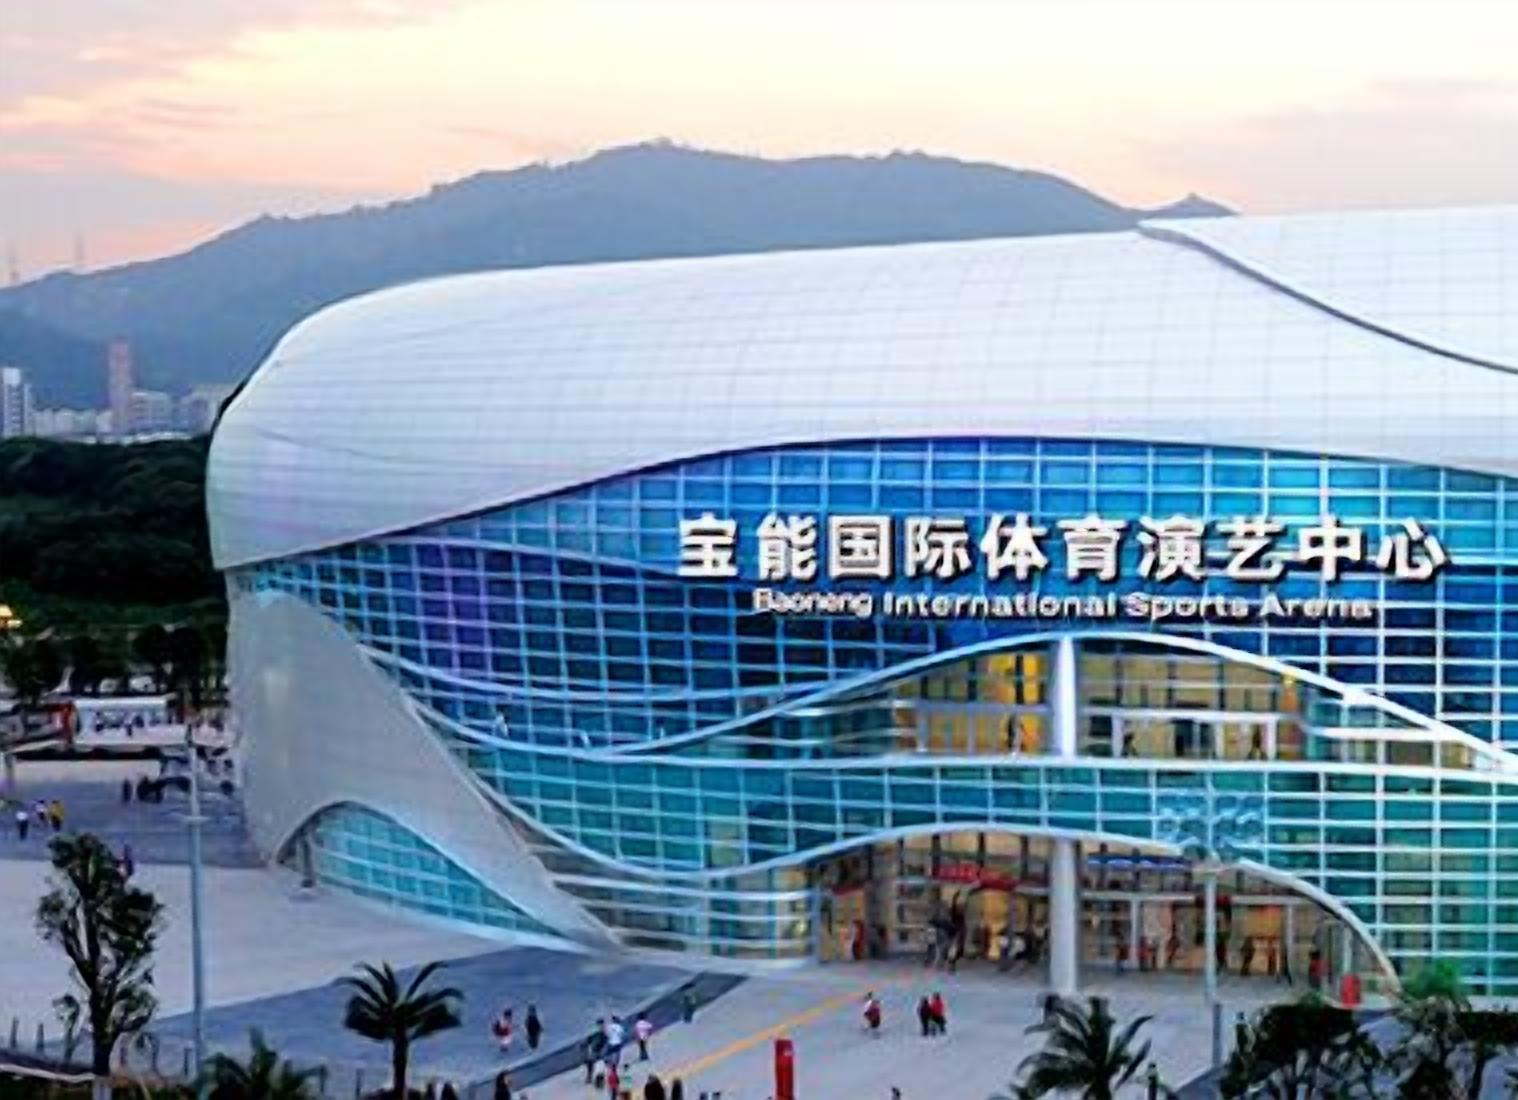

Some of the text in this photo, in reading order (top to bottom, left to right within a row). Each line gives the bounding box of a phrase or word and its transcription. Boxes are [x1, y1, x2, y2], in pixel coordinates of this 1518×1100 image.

[678, 512, 1448, 582] 宝能国际体育演艺中心
[884, 591, 1115, 617] International
[1124, 590, 1247, 622] Sports
[1259, 592, 1372, 618] Arena
